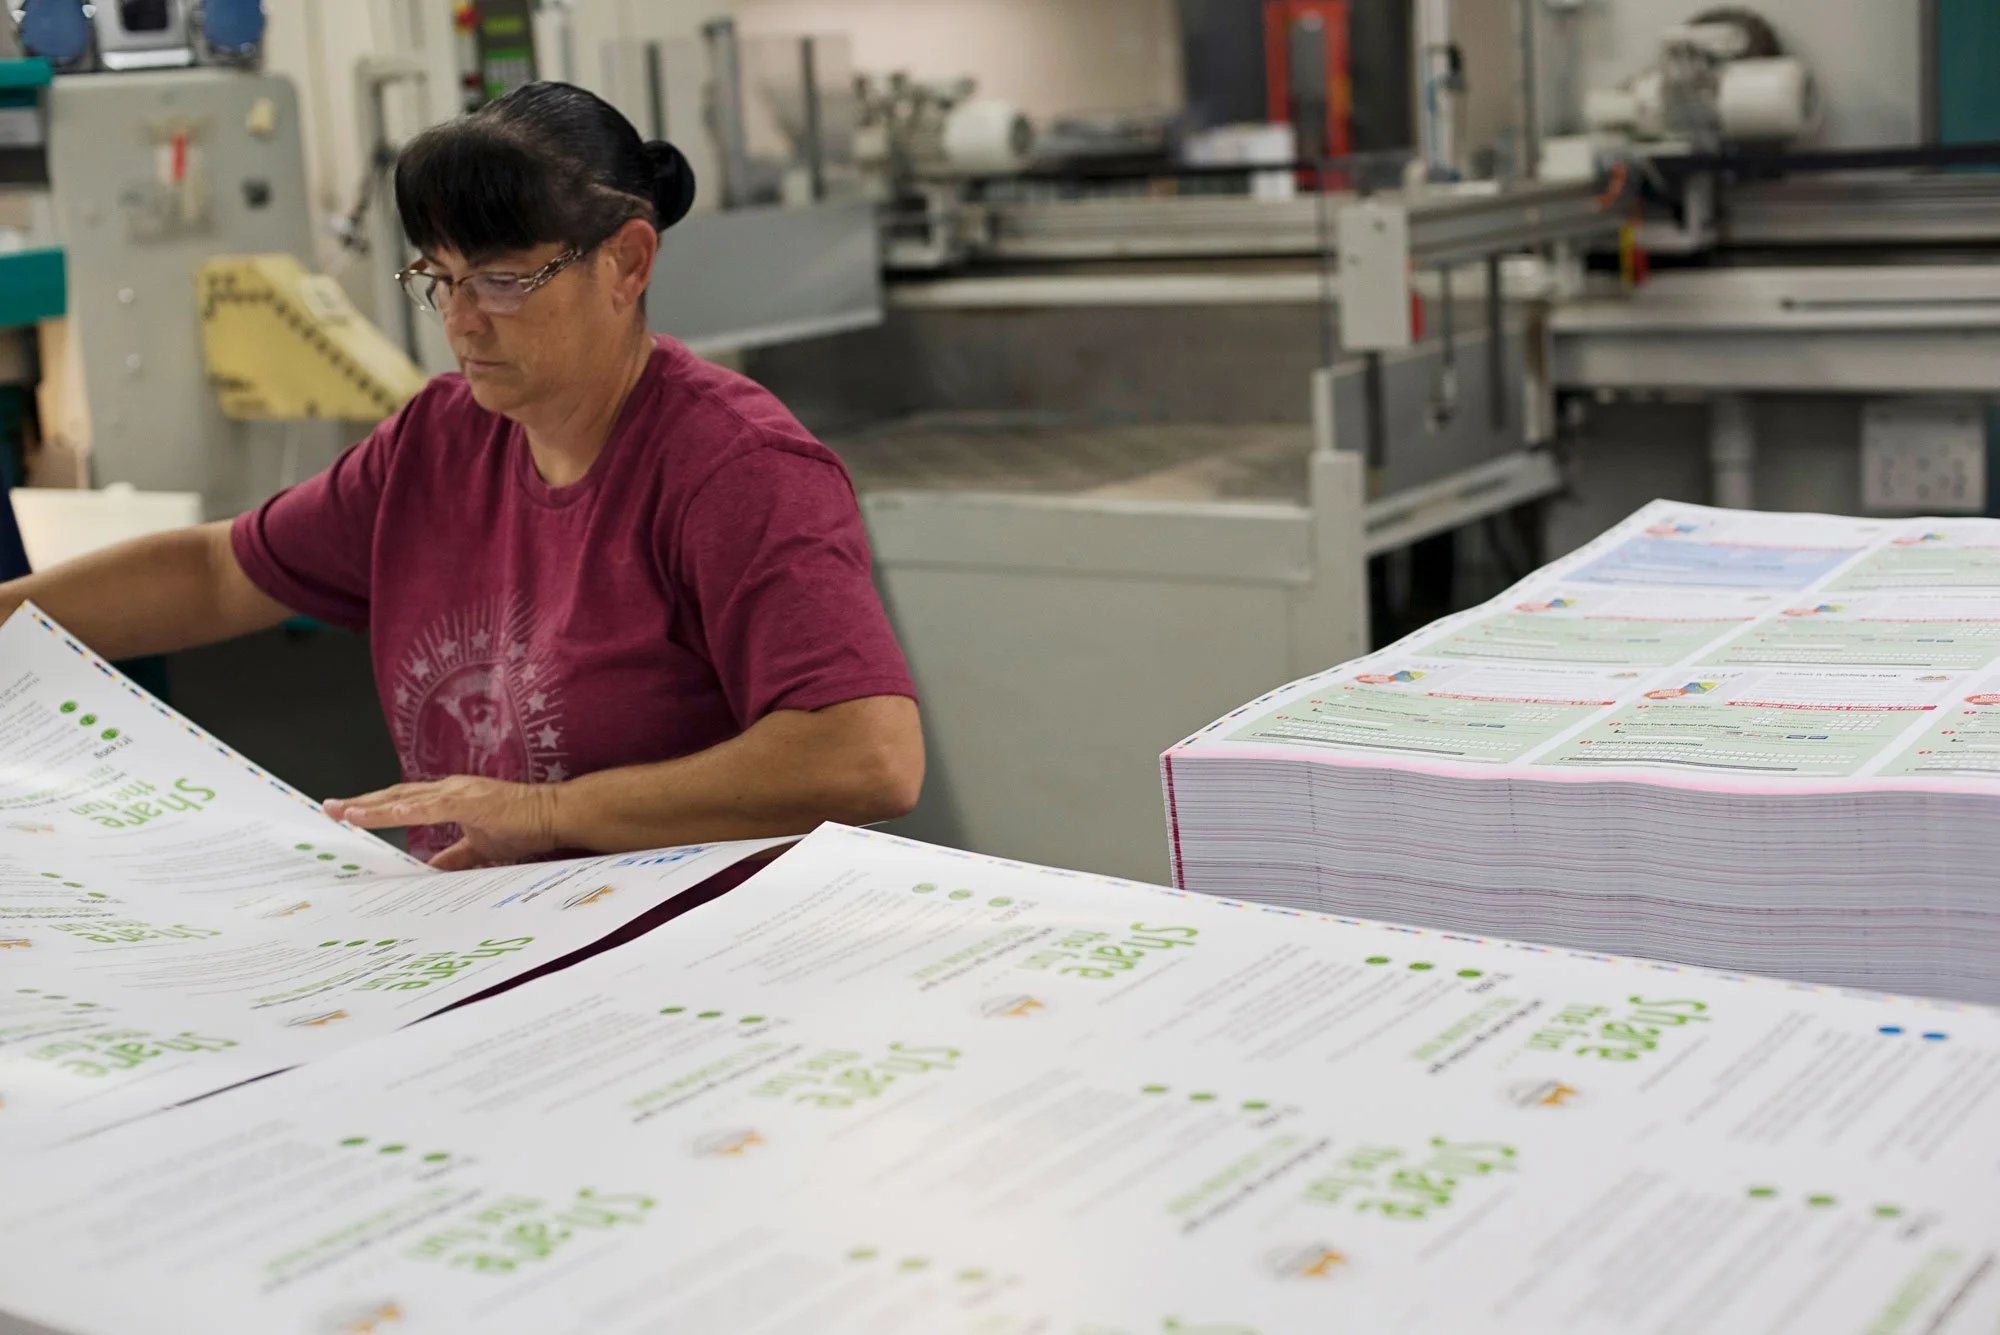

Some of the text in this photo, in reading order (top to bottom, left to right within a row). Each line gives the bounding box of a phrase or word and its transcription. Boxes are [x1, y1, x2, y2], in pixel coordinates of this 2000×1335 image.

[69, 800, 118, 816] fun
[89, 778, 216, 829] Share
[109, 780, 156, 802] the
[72, 925, 222, 944] Share
[1058, 923, 1198, 979] Share
[382, 936, 536, 991] Share
